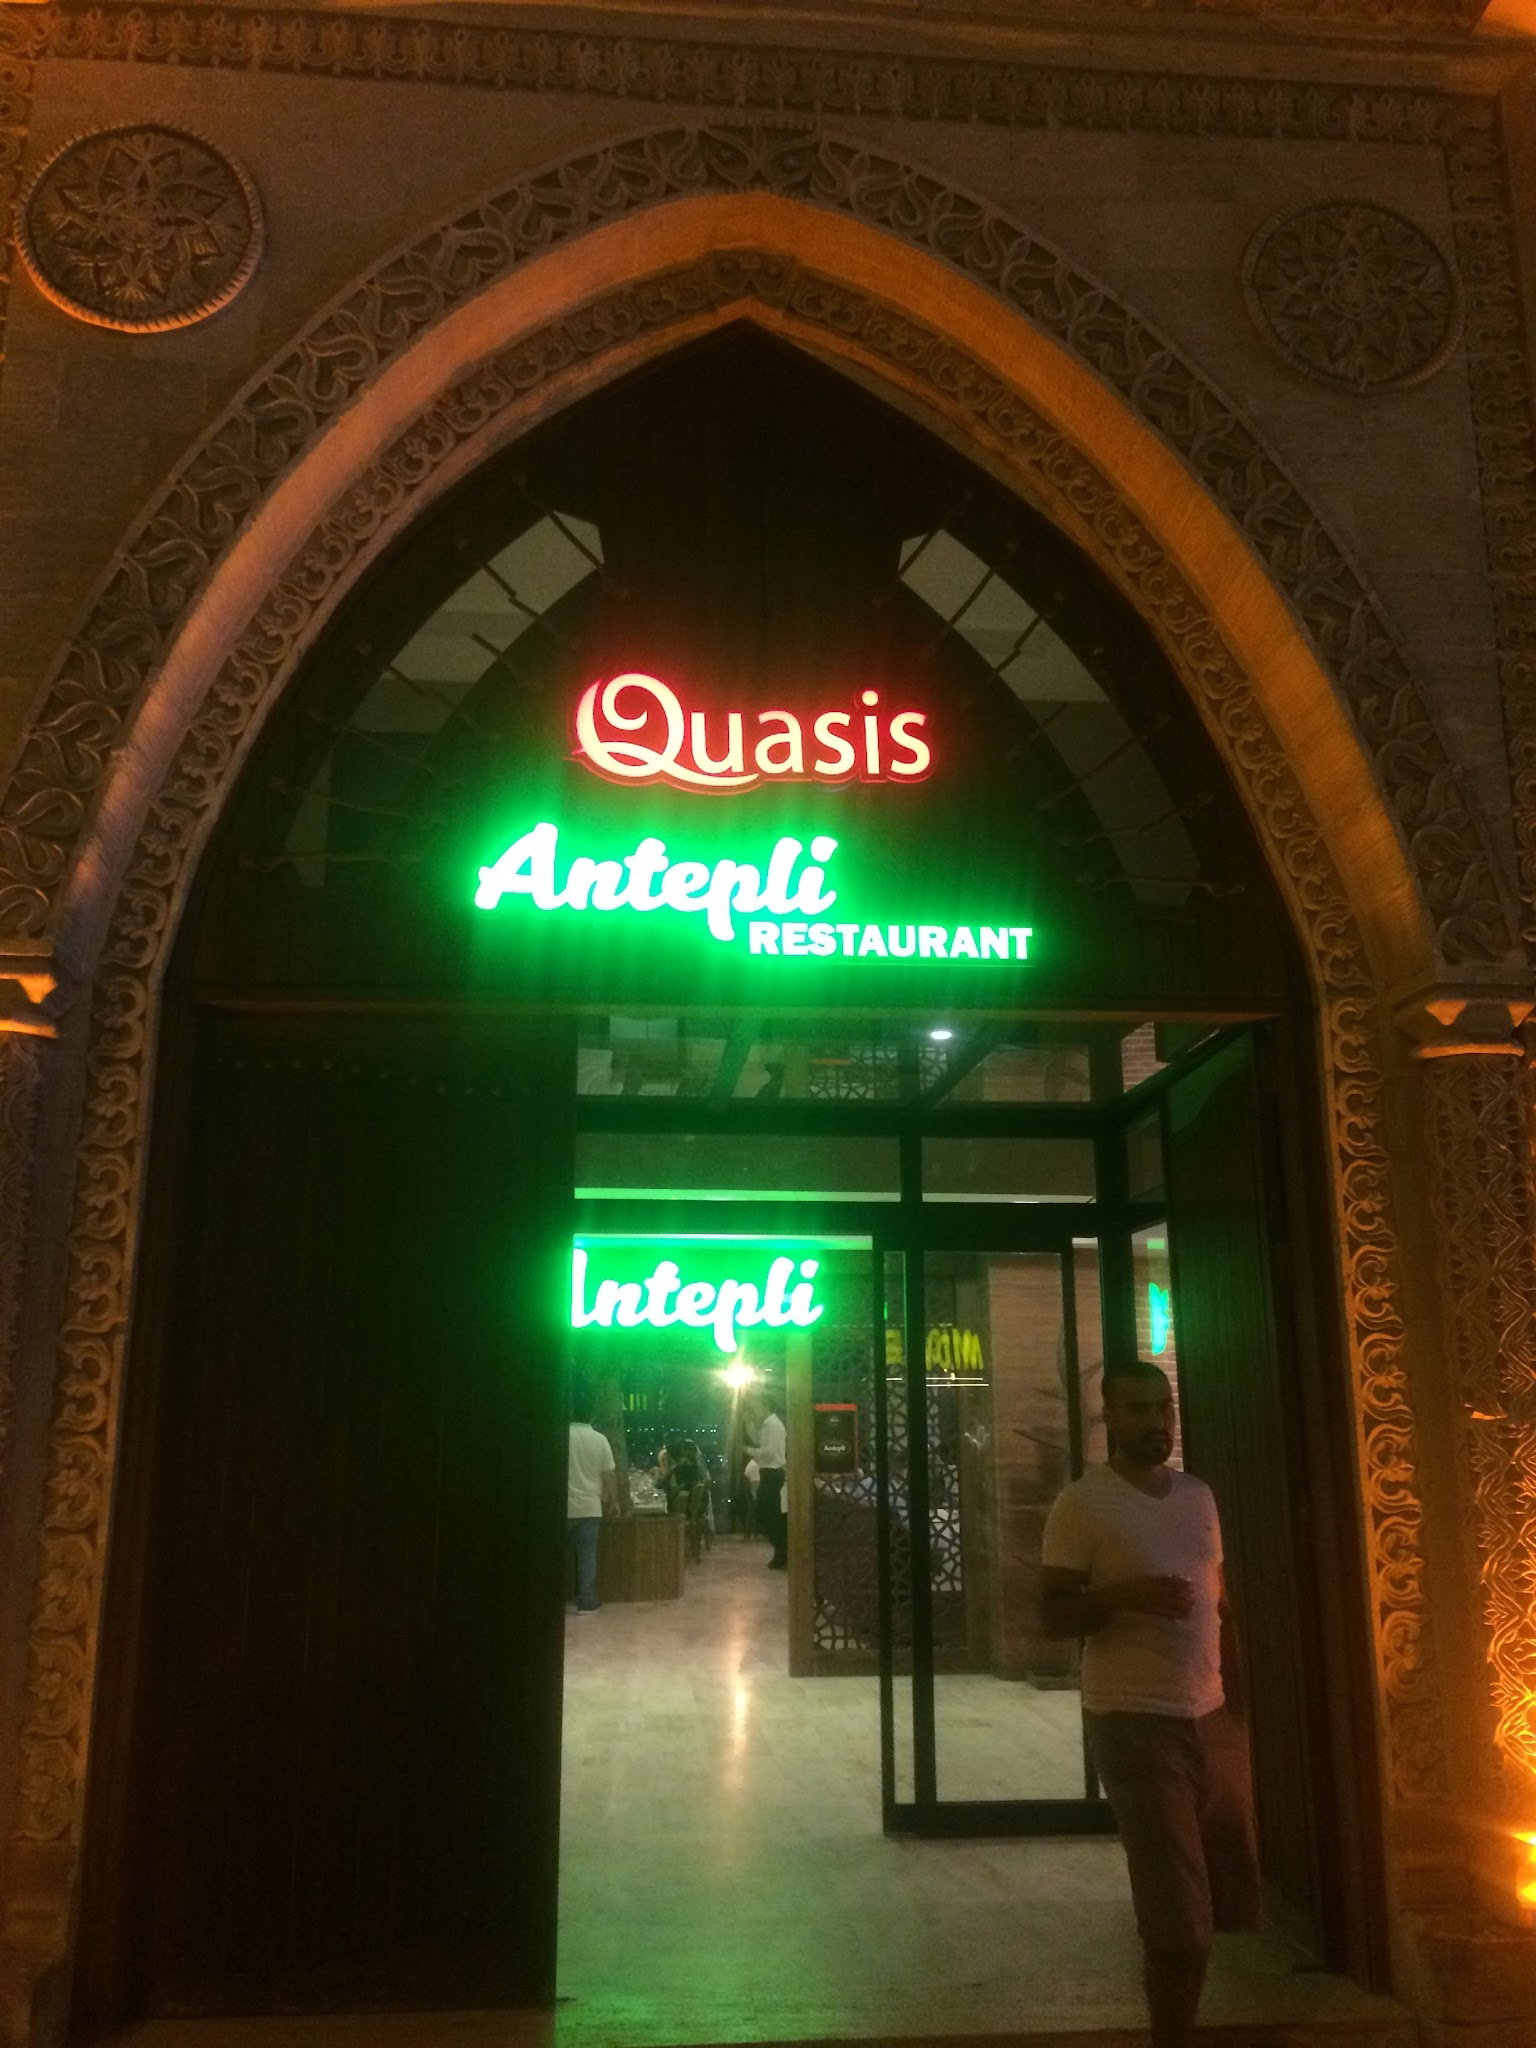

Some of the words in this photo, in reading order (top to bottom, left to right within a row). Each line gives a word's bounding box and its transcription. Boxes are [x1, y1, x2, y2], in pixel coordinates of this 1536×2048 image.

[575, 673, 932, 786] Quasis
[474, 822, 838, 941] Antepli
[749, 921, 1032, 960] RESTAURANT
